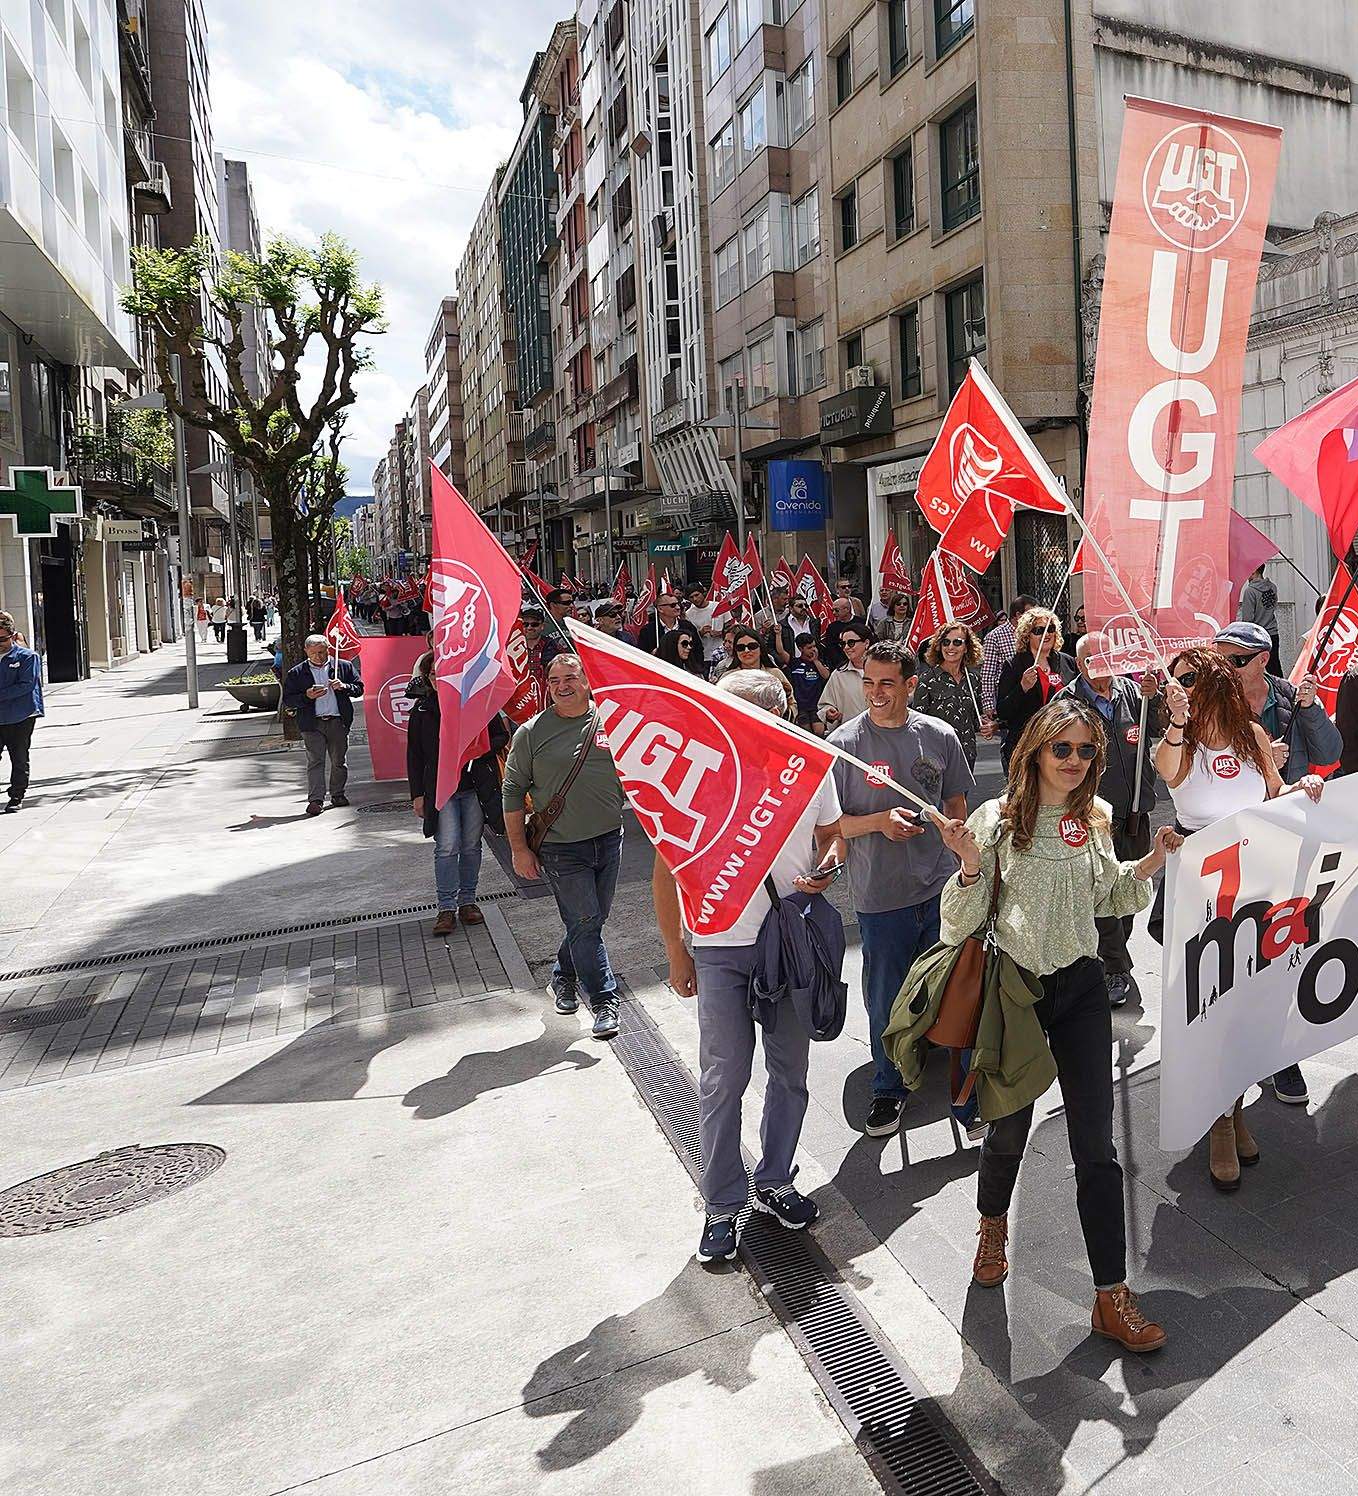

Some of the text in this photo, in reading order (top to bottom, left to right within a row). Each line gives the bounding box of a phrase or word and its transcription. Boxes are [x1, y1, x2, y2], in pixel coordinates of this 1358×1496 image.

[1160, 142, 1237, 197] UGT
[1127, 250, 1229, 609] UGT
[107, 527, 139, 535] Bross
[654, 544, 681, 552] ATLEET
[1215, 756, 1237, 769] UGT
[697, 753, 808, 925] www.UGT.es
